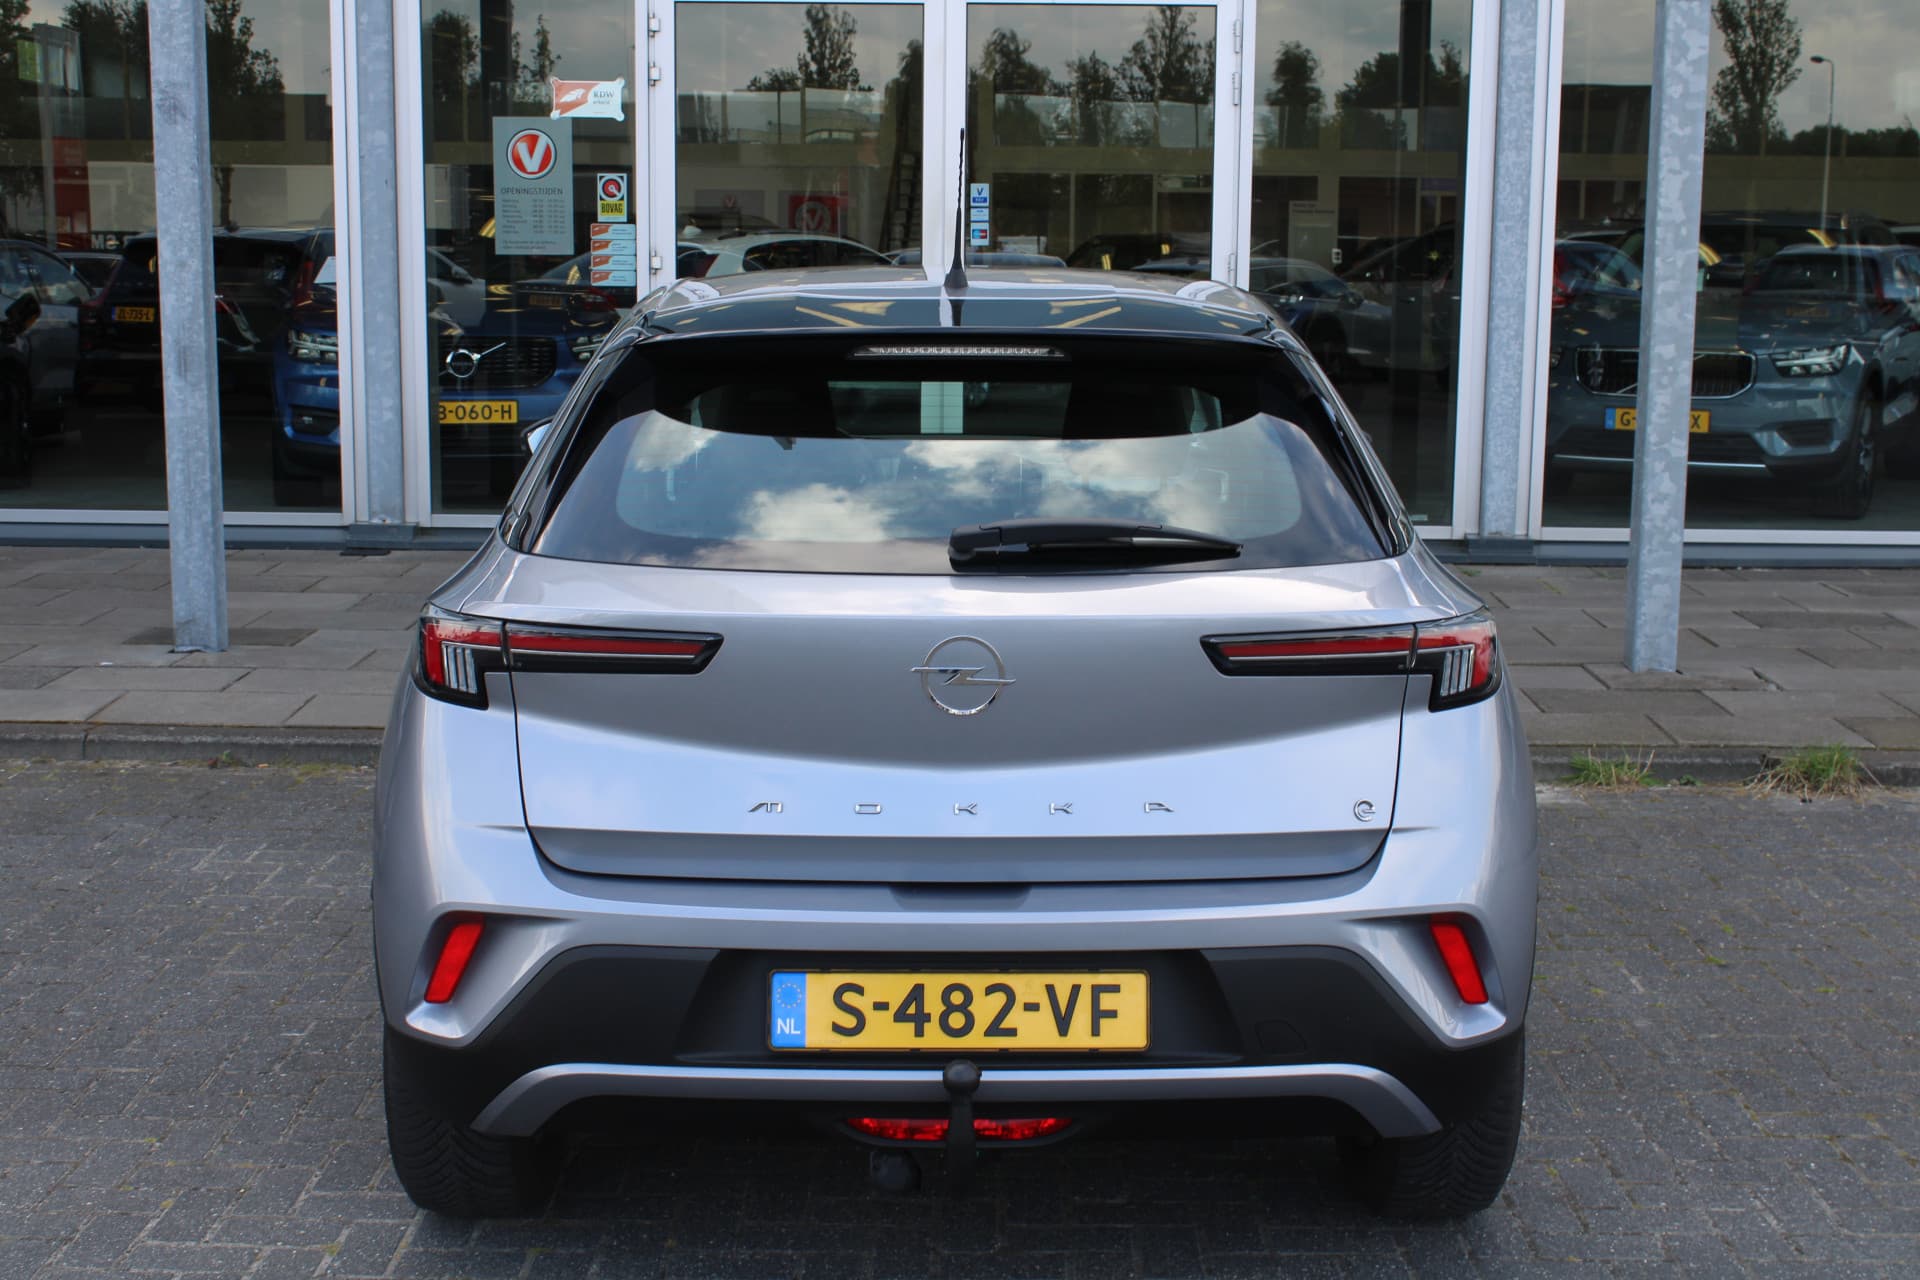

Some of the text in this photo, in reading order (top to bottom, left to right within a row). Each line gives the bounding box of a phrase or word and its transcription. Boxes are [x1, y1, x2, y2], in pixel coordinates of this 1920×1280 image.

[600, 202, 624, 214] BOVAG
[748, 801, 1175, 815] MOKKA
[831, 982, 1121, 1038] S-482-VF
[777, 1018, 801, 1035] NL
